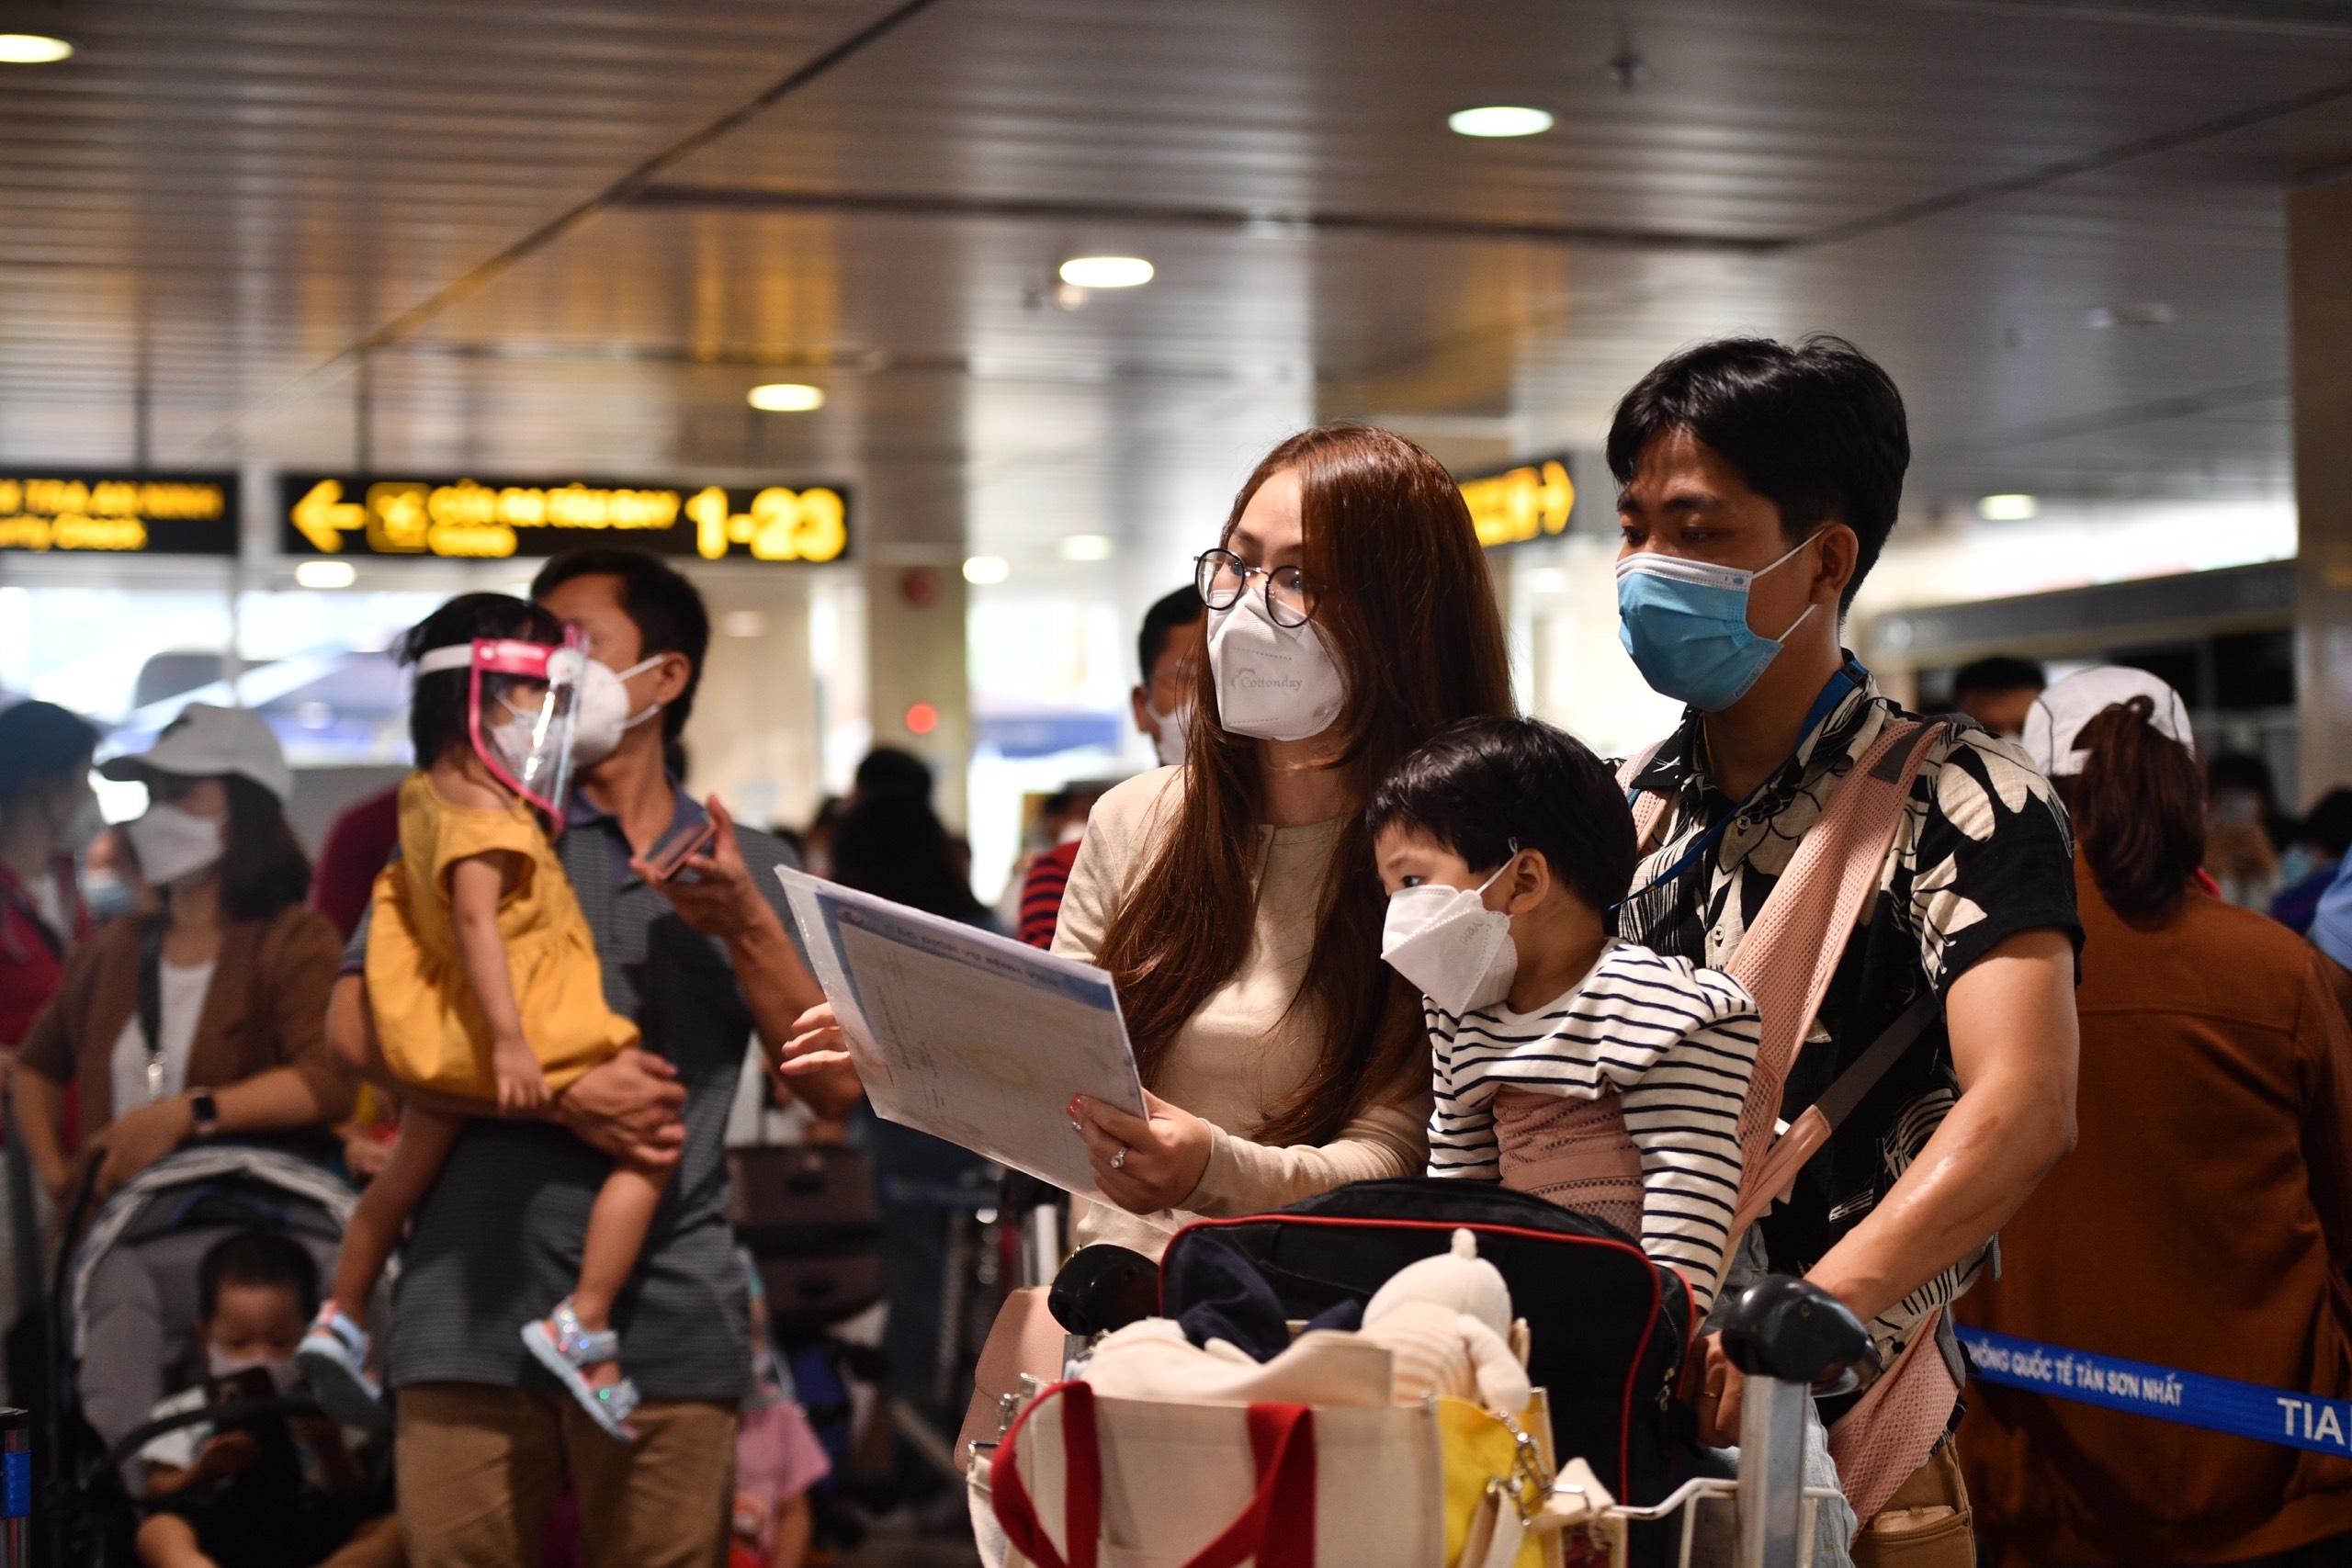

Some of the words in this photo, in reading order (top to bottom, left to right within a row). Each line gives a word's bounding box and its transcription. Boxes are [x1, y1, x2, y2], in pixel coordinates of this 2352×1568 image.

[684, 486, 846, 561] 1-23
[1239, 675, 1303, 692] Cottonday
[1964, 1337, 2009, 1373] HÔNG
[2012, 1347, 2052, 1382] QUỐC
[2054, 1353, 2074, 1386] TẾ
[2075, 1359, 2105, 1393] TÂN
[2107, 1371, 2140, 1400] SƠN
[2142, 1373, 2183, 1407] NHẤT
[2277, 1396, 2345, 1446] TIA
